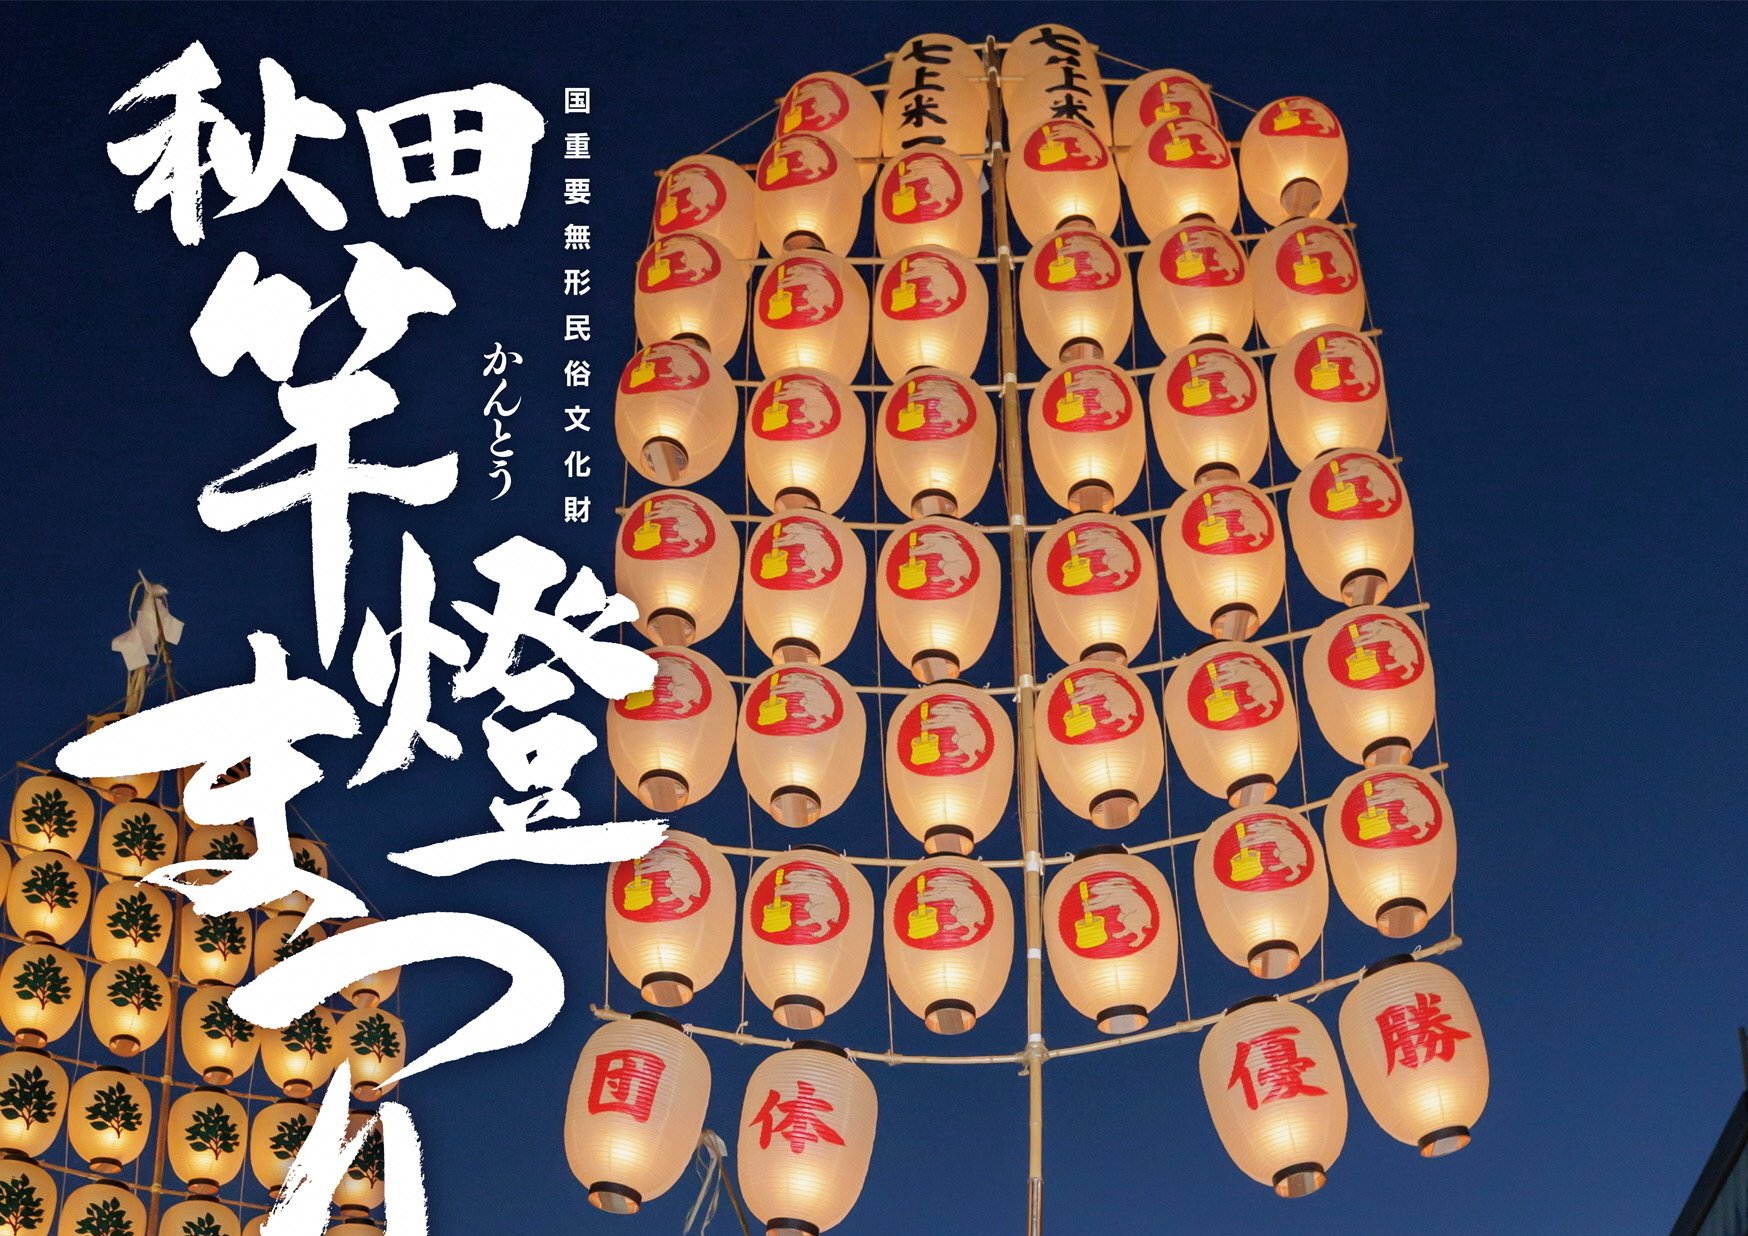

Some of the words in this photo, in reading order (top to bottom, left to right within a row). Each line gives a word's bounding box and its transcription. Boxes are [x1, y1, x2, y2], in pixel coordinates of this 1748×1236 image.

[587, 1048, 666, 1124] 団
[1226, 1025, 1329, 1111] 優
[1374, 991, 1474, 1078] 勝
